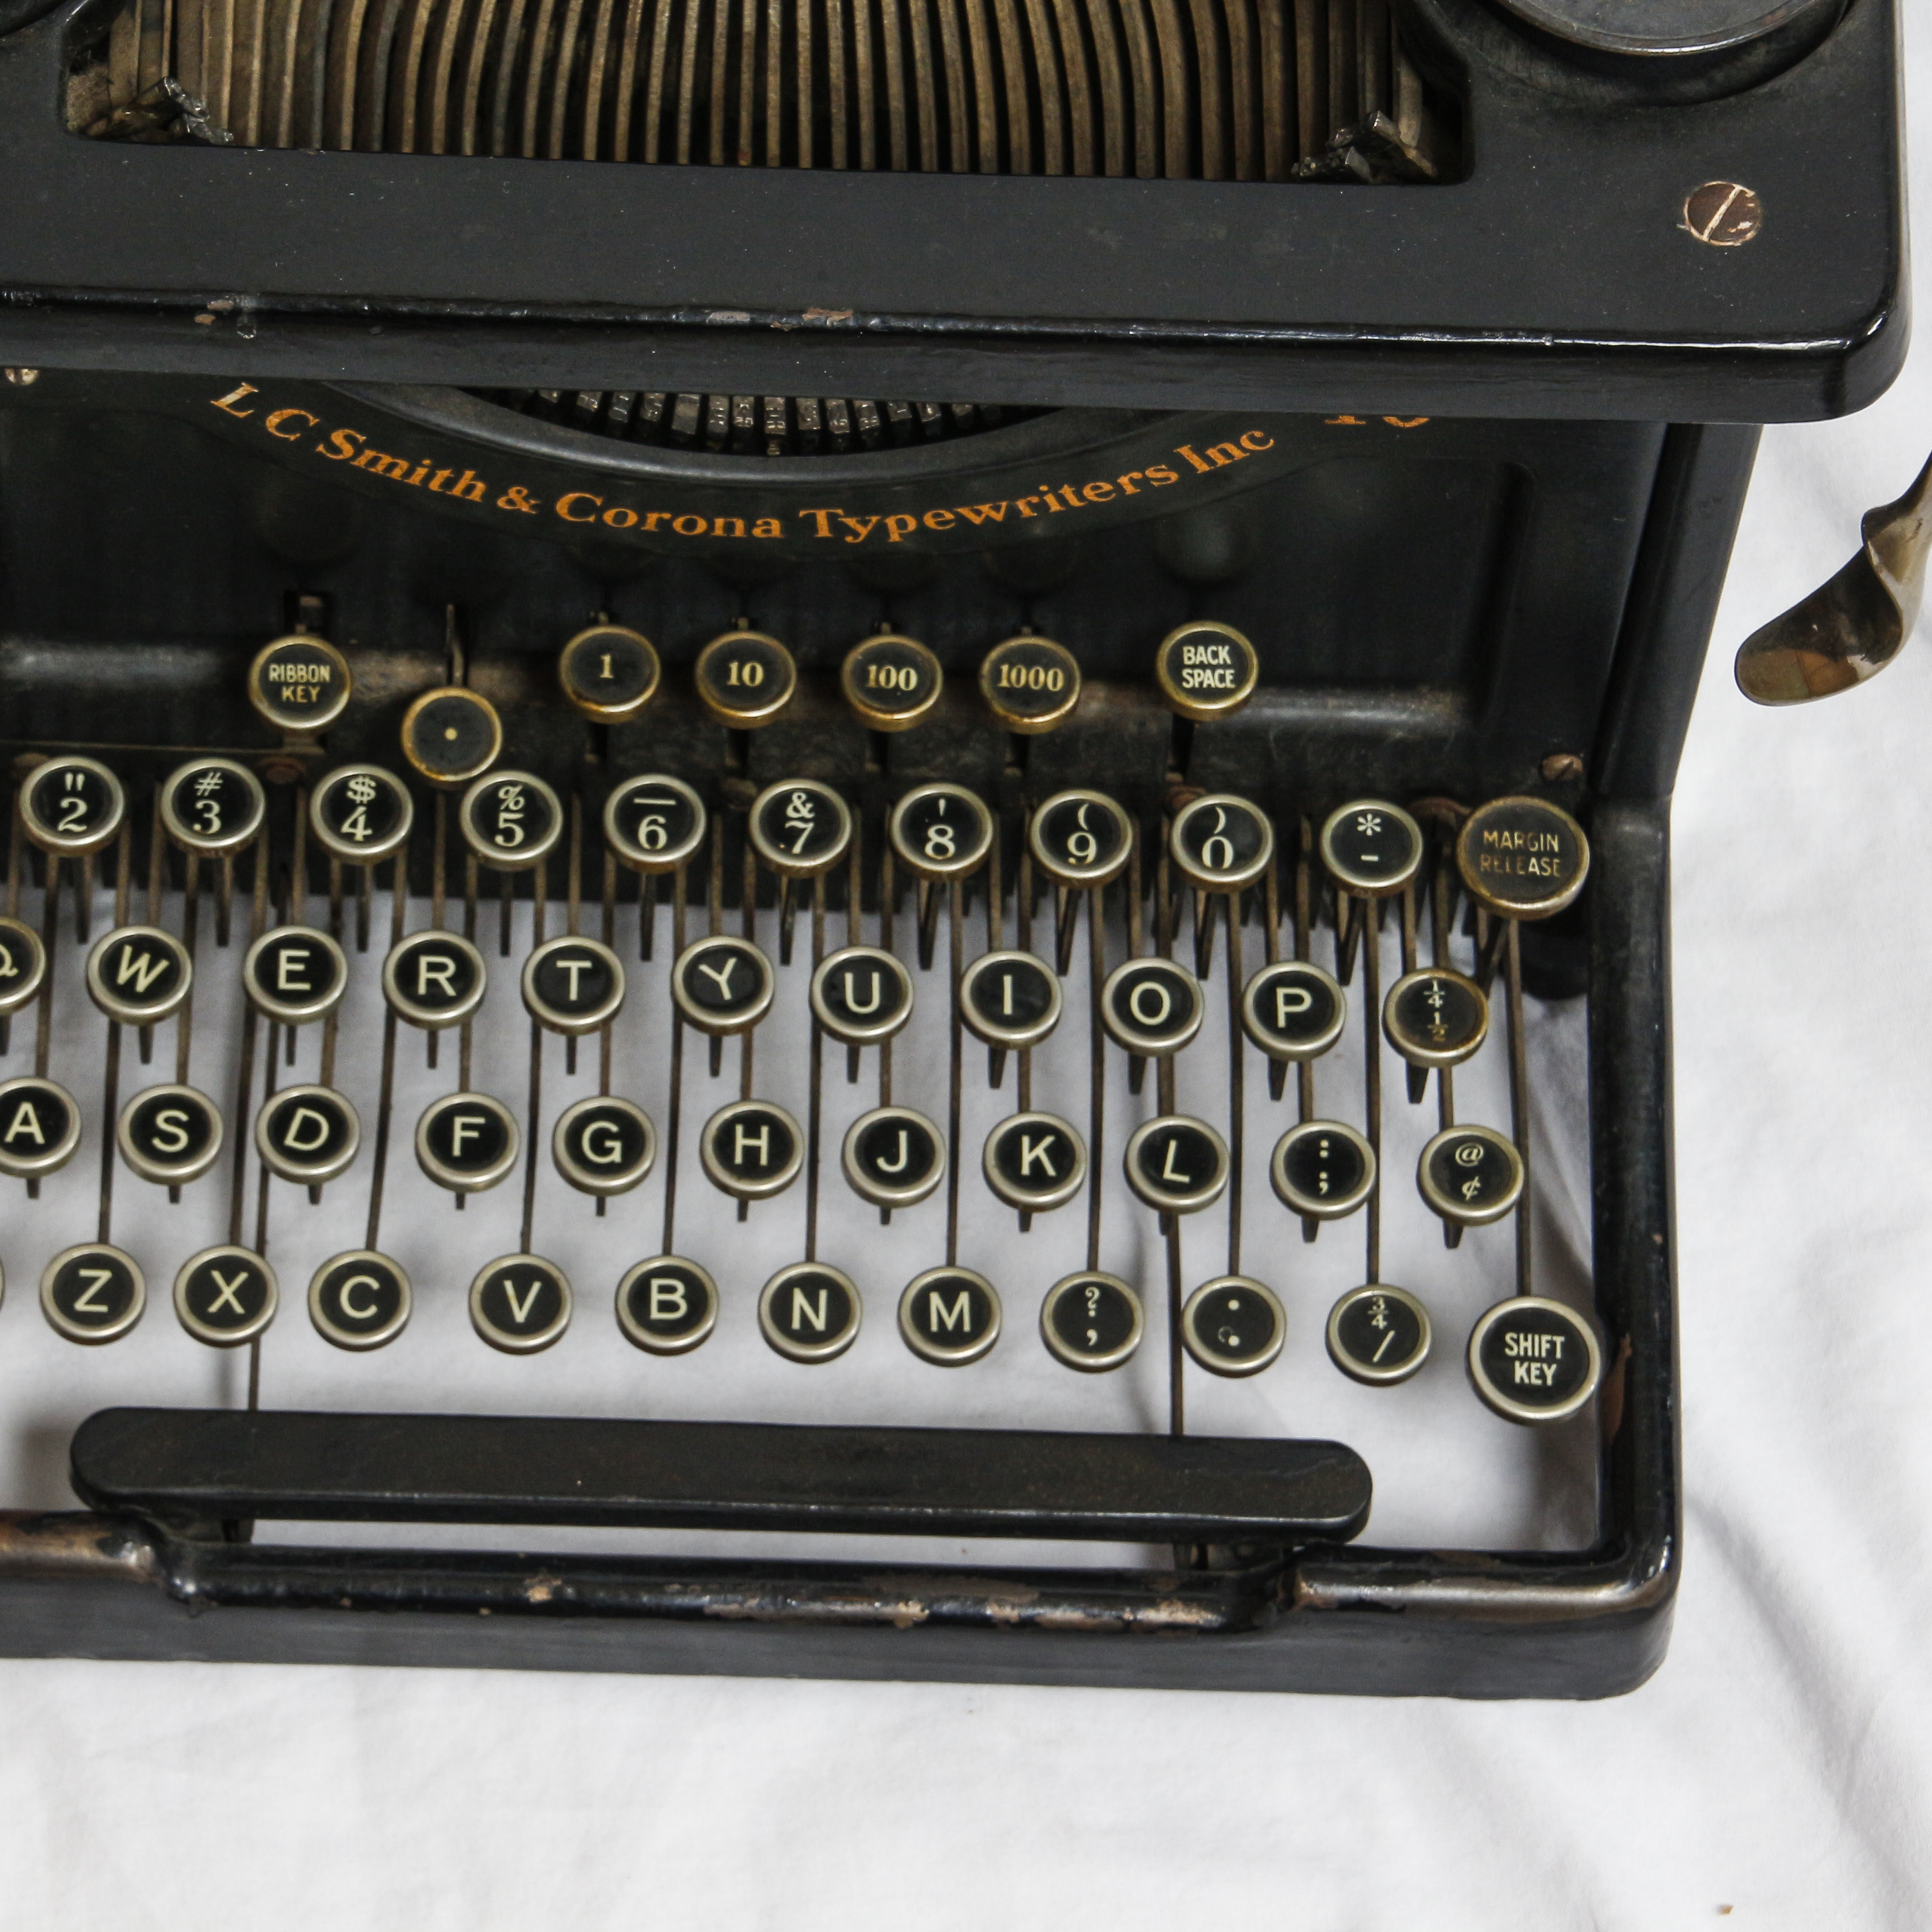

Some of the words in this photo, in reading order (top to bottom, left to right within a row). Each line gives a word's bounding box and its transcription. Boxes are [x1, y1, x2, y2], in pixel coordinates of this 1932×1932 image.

[210, 382, 259, 418] L
[265, 408, 320, 441] C
[316, 428, 487, 504] Smith
[496, 486, 539, 514] &
[555, 492, 783, 538] Corona
[799, 464, 1179, 543] Typewriters
[1174, 429, 1275, 474] Inc
[600, 653, 613, 678] 1
[1182, 645, 1232, 665] BACK
[269, 664, 330, 683] RIBBON
[728, 661, 764, 686] 10
[868, 665, 918, 691] 100
[998, 664, 1064, 691] 1000
[1182, 668, 1235, 688] SPACE
[281, 685, 320, 703] KEY
[193, 771, 224, 797] #
[346, 775, 377, 803] $
[498, 784, 525, 811] %
[57, 797, 87, 832] 2
[192, 800, 222, 834] 3
[784, 791, 815, 819] &
[340, 807, 373, 842] 4
[495, 812, 524, 847] 5
[638, 815, 667, 850] 6
[784, 819, 815, 855] 7
[925, 824, 956, 860] 8
[1483, 830, 1559, 853] MARGIN
[1067, 832, 1097, 865] 9
[1201, 836, 1234, 869] 0
[1480, 854, 1560, 877] RELEASE
[116, 944, 170, 993] W
[278, 949, 311, 990] E
[418, 955, 456, 996] R
[556, 960, 592, 1001] T
[698, 957, 737, 1000] Y
[844, 972, 881, 1014] U
[1003, 974, 1013, 1015] I
[1130, 981, 1171, 1025] O
[1276, 987, 1312, 1028] P
[4, 1102, 45, 1144] A
[152, 1110, 189, 1152] S
[284, 1107, 329, 1151] D
[453, 1116, 486, 1157] F
[581, 1120, 622, 1164] G
[734, 1124, 769, 1166] H
[877, 1130, 908, 1173] J
[1021, 1135, 1056, 1177] K
[1455, 1144, 1484, 1167] @
[1163, 1140, 1190, 1183] L
[1462, 1176, 1481, 1201] ¢
[73, 1268, 112, 1313] Z
[208, 1270, 249, 1314] X
[339, 1275, 380, 1319] C
[503, 1280, 542, 1323] V
[649, 1278, 687, 1320] B
[1085, 1286, 1100, 1318] ?
[791, 1288, 827, 1331] N
[929, 1291, 970, 1332] M
[1504, 1332, 1565, 1359] SHIFT
[1514, 1360, 1557, 1386] KEY
